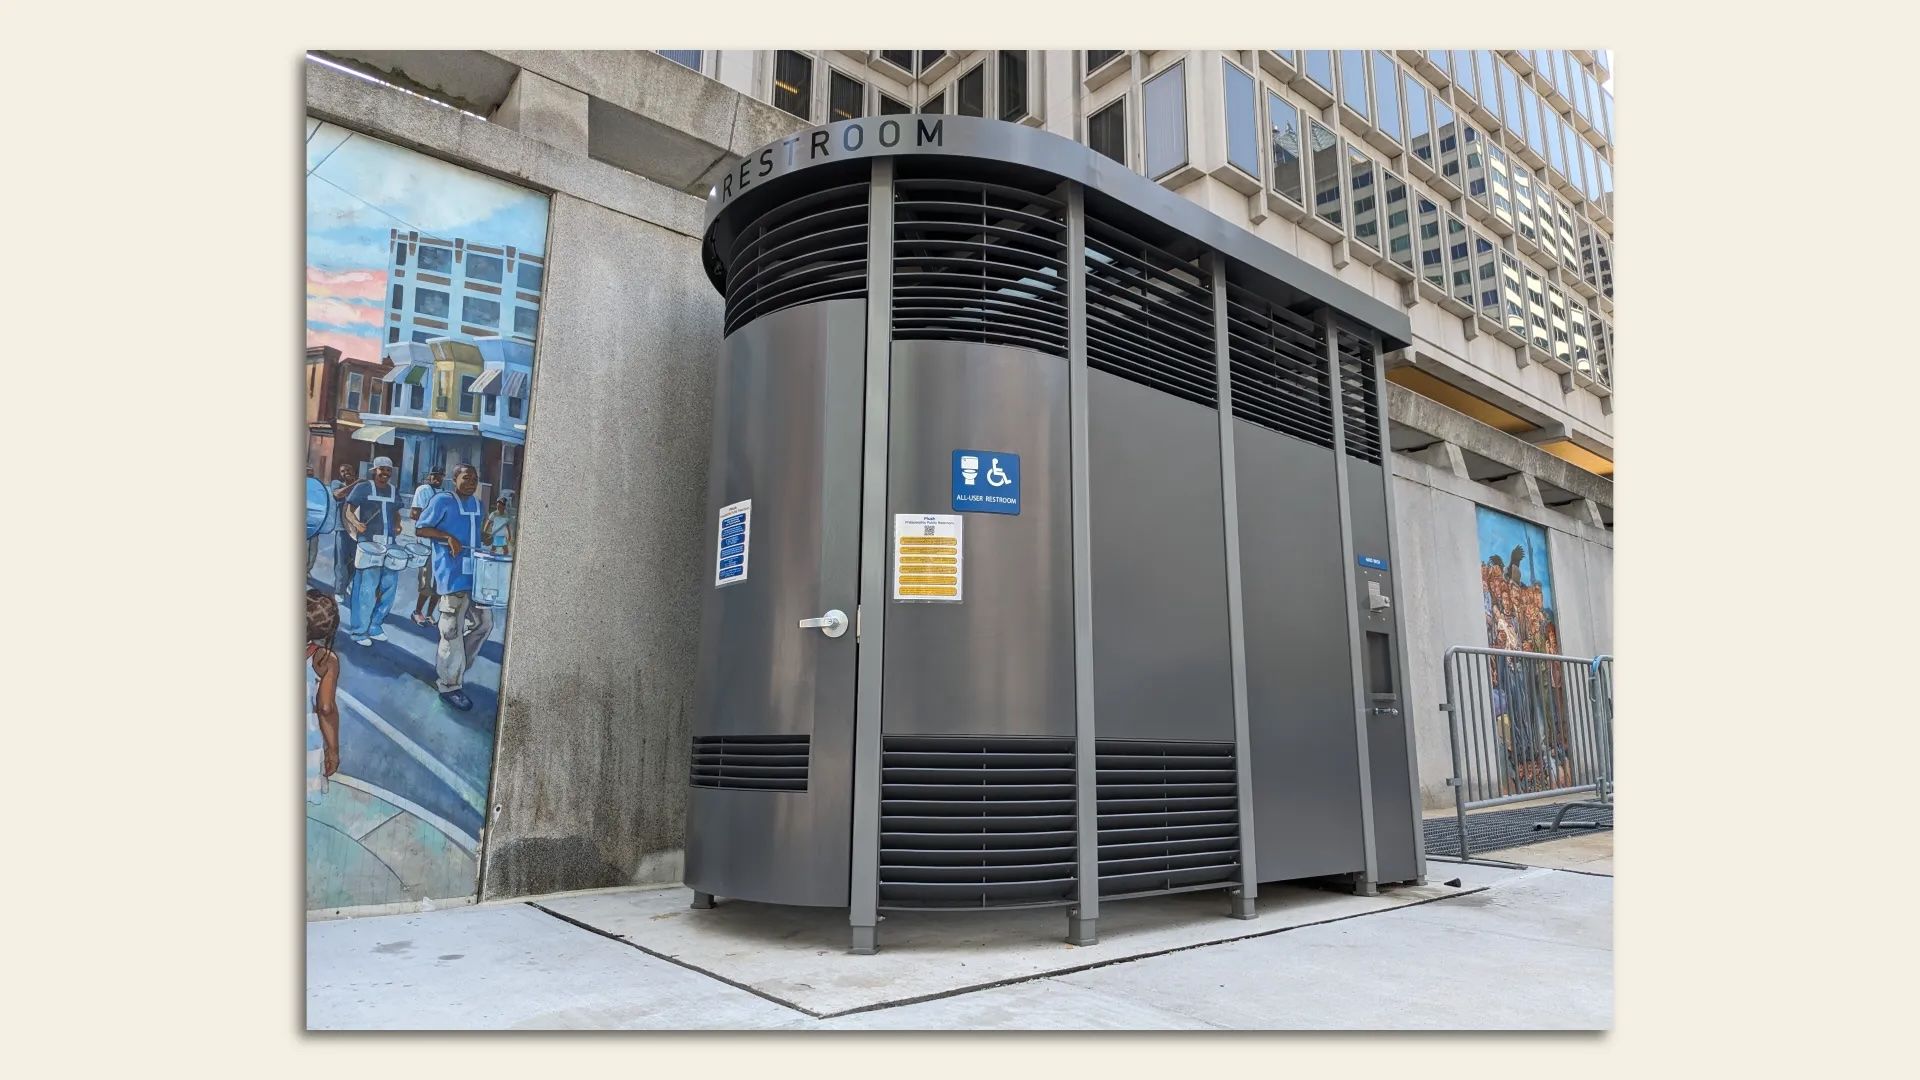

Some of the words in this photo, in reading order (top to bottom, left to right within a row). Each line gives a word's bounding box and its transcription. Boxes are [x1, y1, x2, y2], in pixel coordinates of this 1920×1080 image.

[722, 119, 943, 203] RESTROOM
[956, 494, 983, 502] ALL-USER
[985, 495, 1017, 504] RESTROOM
